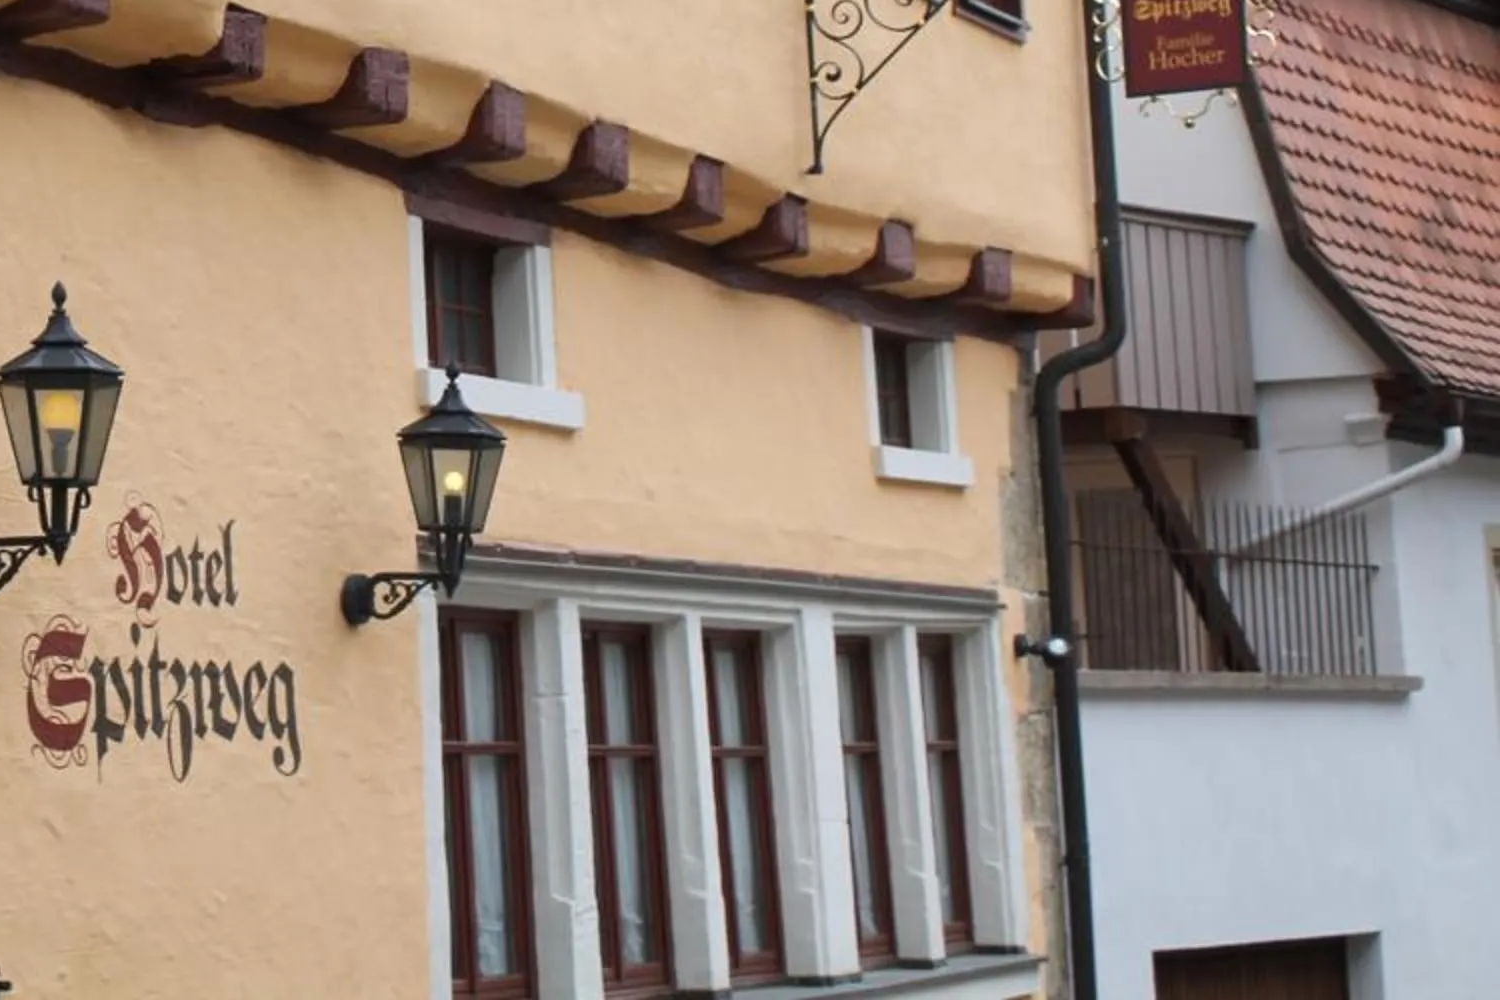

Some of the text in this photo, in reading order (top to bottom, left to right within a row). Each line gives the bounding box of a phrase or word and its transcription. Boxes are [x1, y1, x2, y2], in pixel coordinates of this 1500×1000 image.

[1148, 48, 1225, 70] Hocher
[1156, 31, 1215, 50] Familie
[105, 491, 239, 628] Hotel
[21, 614, 302, 784] Spitzweg
